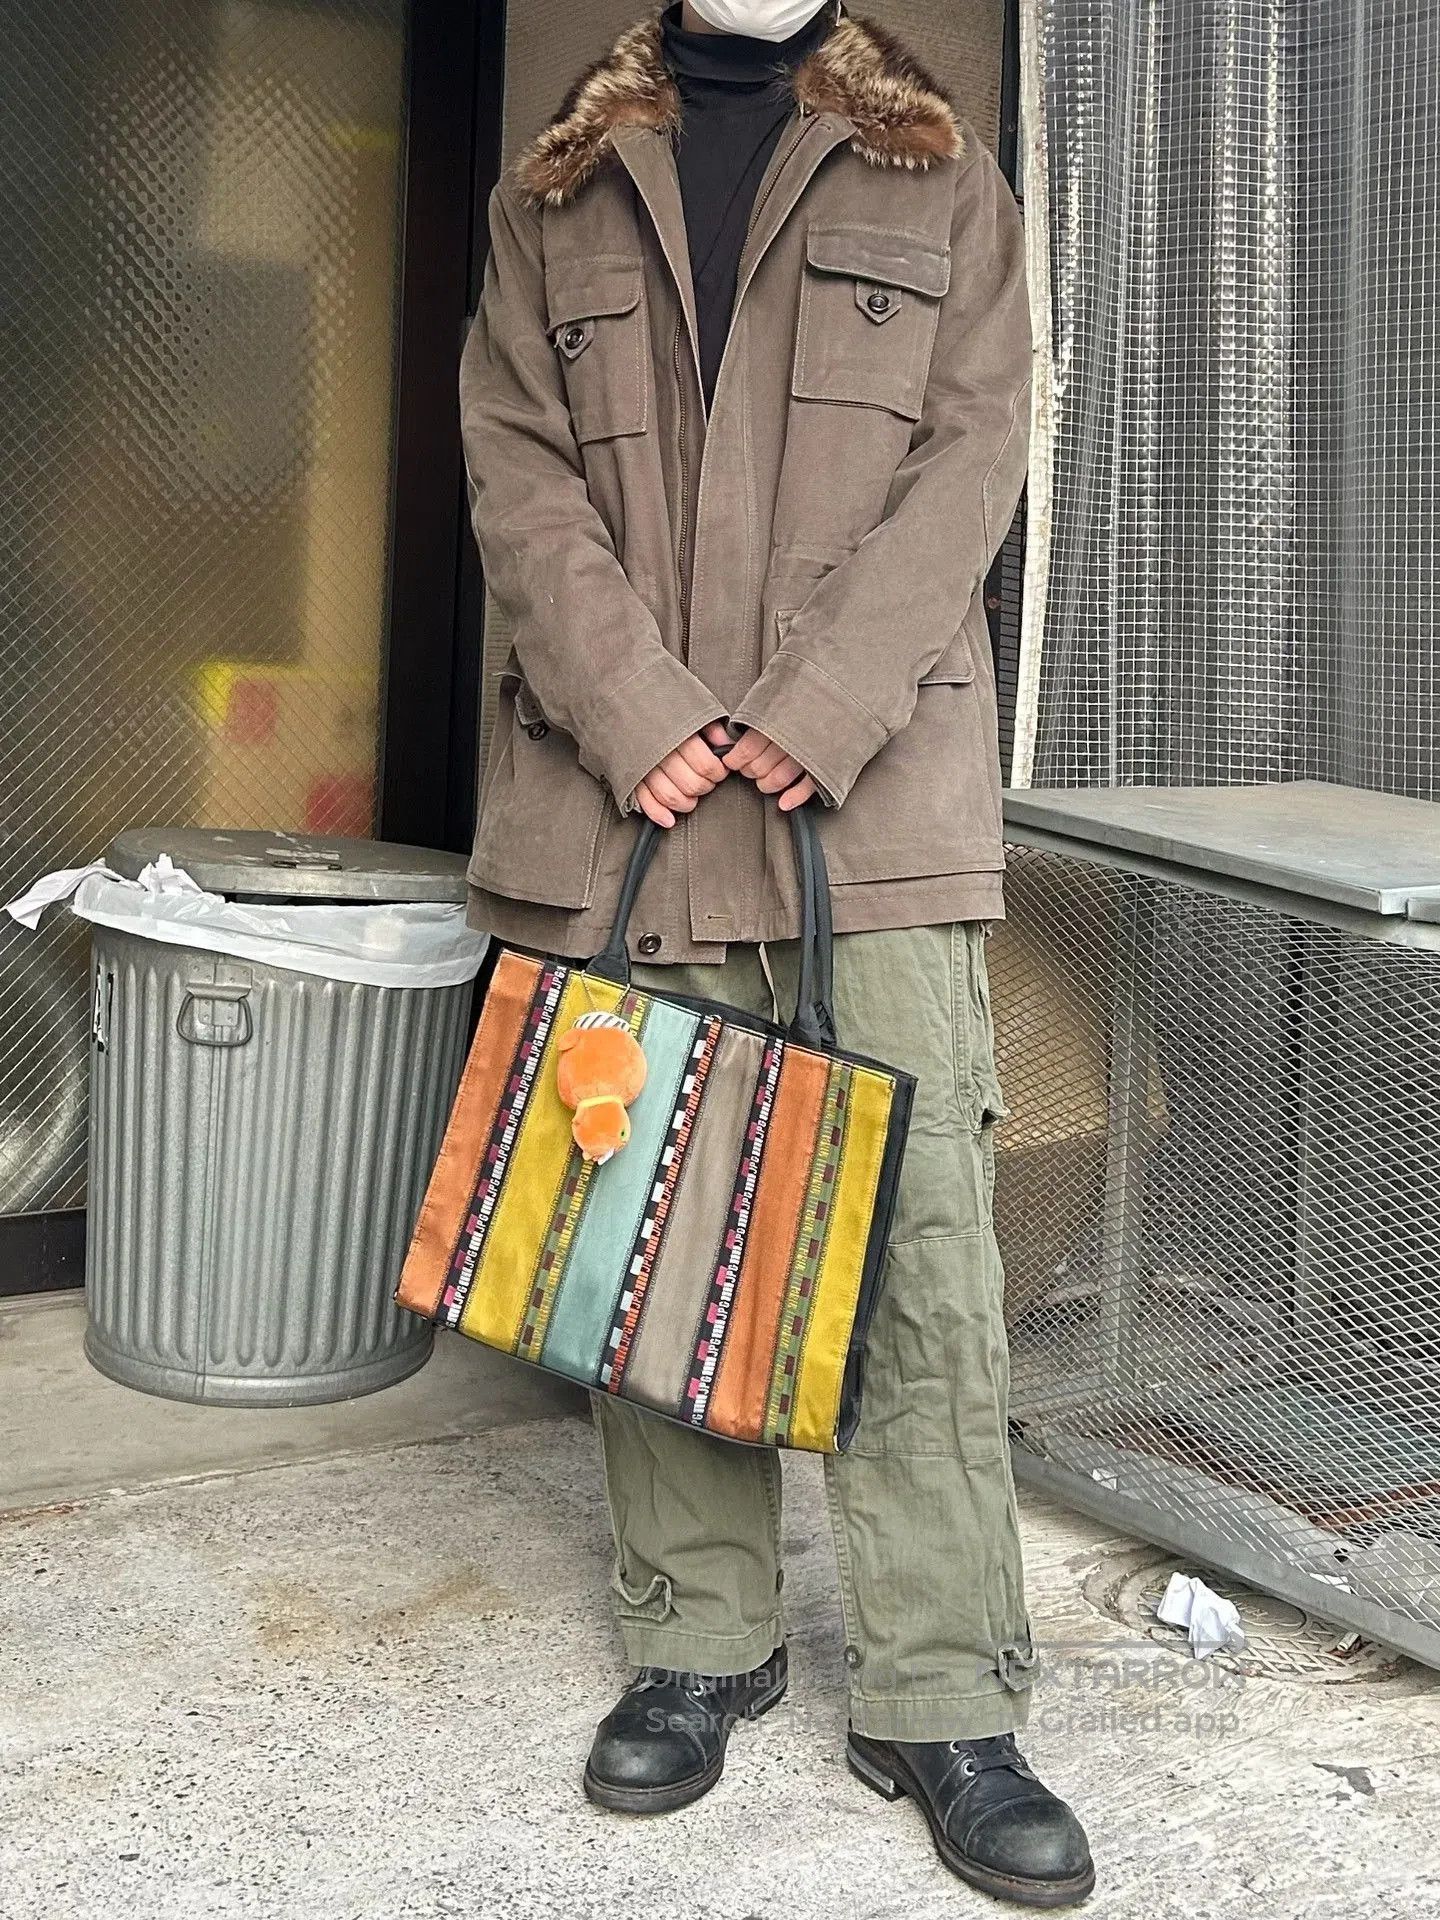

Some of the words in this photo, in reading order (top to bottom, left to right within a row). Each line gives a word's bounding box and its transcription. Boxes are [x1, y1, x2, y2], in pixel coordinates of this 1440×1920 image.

[769, 1046, 784, 1067] JPG
[761, 1083, 776, 1103] JPG
[451, 1283, 468, 1305] JPG
[462, 1248, 479, 1269] JPG
[473, 1212, 489, 1233] JPG
[485, 1177, 500, 1197] JPG
[495, 1142, 511, 1163] JPG
[506, 1107, 521, 1127] JPG
[517, 1072, 533, 1092] JPG
[528, 1038, 544, 1058] JPG
[539, 1004, 555, 1024] JPG
[549, 970, 565, 990] JPG
[753, 1118, 768, 1139] JPG
[746, 1155, 760, 1174] JPG
[619, 1326, 634, 1347] JPG
[629, 1288, 645, 1310] JPG
[639, 1252, 655, 1273] JPG
[650, 1216, 665, 1237] JPG
[660, 1180, 676, 1200] JPG
[670, 1143, 686, 1164] JPG
[681, 1107, 696, 1128] JPG
[691, 1071, 706, 1092] JPG
[701, 1036, 716, 1056] JPG
[740, 1190, 753, 1210] JPG
[732, 1226, 747, 1246] JPG
[723, 1262, 739, 1283] JPG
[714, 1299, 730, 1321] JPG
[705, 1336, 721, 1357] JPG
[697, 1374, 713, 1395] JPG
